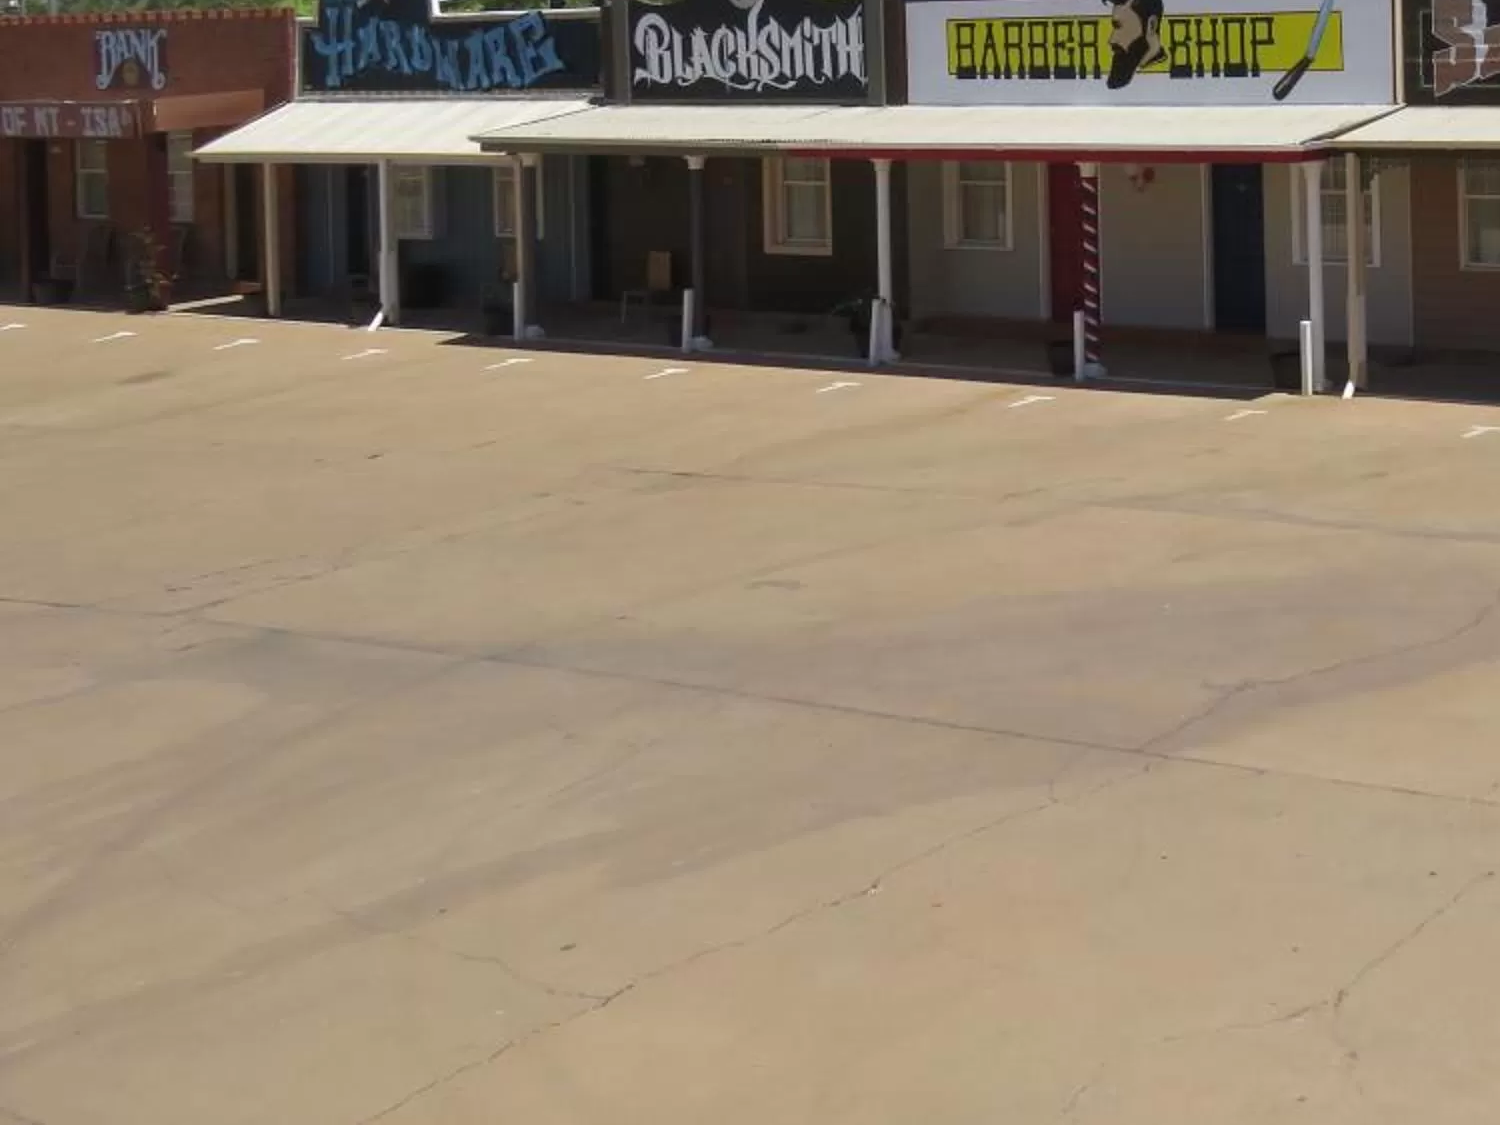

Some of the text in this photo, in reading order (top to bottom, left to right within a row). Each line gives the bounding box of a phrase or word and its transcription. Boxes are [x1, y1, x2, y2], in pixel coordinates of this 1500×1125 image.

[95, 28, 168, 91] BANK
[311, 6, 566, 91] HARDWARE
[955, 20, 1102, 80] BARBER
[1, 106, 27, 136] OF
